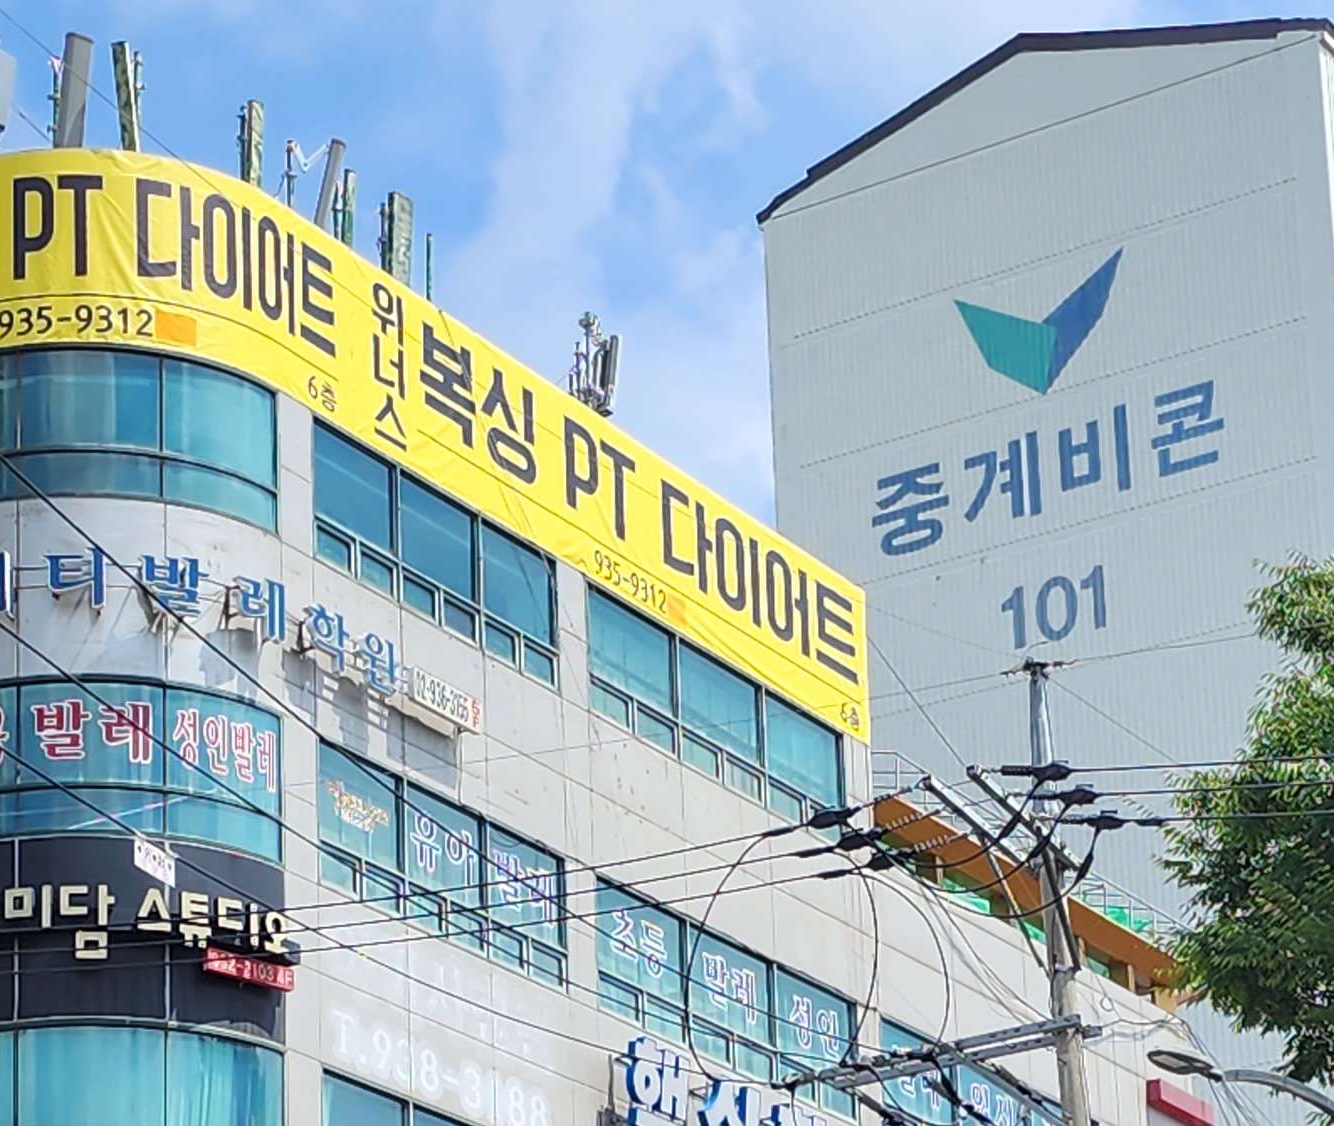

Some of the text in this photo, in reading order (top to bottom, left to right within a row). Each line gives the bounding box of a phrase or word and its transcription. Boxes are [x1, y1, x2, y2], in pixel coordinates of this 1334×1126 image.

[13, 175, 103, 280] PT
[136, 177, 337, 358] 다이어트
[308, 376, 336, 413] 6층
[372, 282, 407, 452] 위너스
[419, 321, 859, 685] 복싱 PT 다이어트
[871, 380, 1225, 557] 중계비콘
[593, 550, 668, 615] 935-9312
[1001, 565, 1107, 650] 101
[32, 699, 152, 763] 발레
[173, 708, 276, 793] 성인발레
[409, 810, 476, 890] 유아
[136, 887, 291, 956] 스튜디오
[610, 907, 668, 980] 초등
